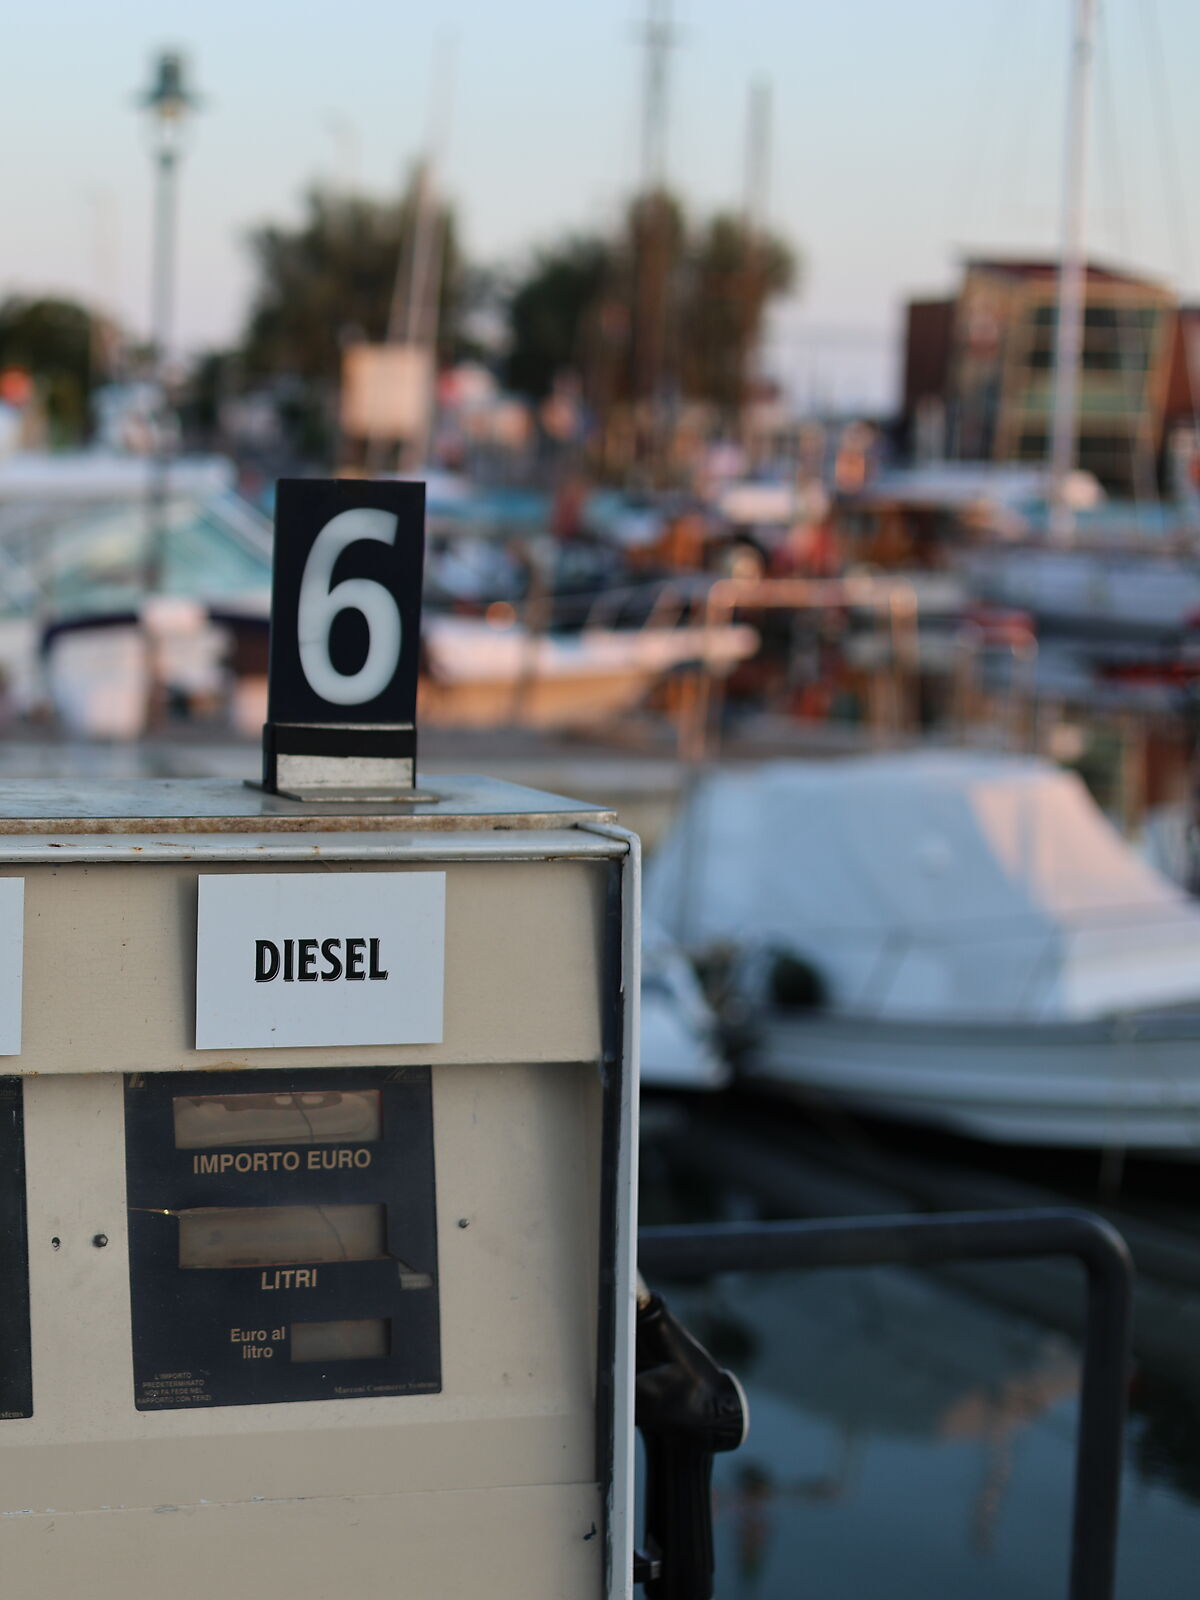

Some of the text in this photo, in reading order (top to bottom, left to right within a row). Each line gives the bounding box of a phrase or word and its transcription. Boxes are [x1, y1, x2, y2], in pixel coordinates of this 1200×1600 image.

[297, 507, 402, 706] 6
[255, 937, 388, 982] DIESEL
[193, 1149, 372, 1174] IMPORTO EURO
[261, 1269, 318, 1290] LITRI
[231, 1326, 286, 1342] Euro al
[243, 1344, 273, 1359] litro
